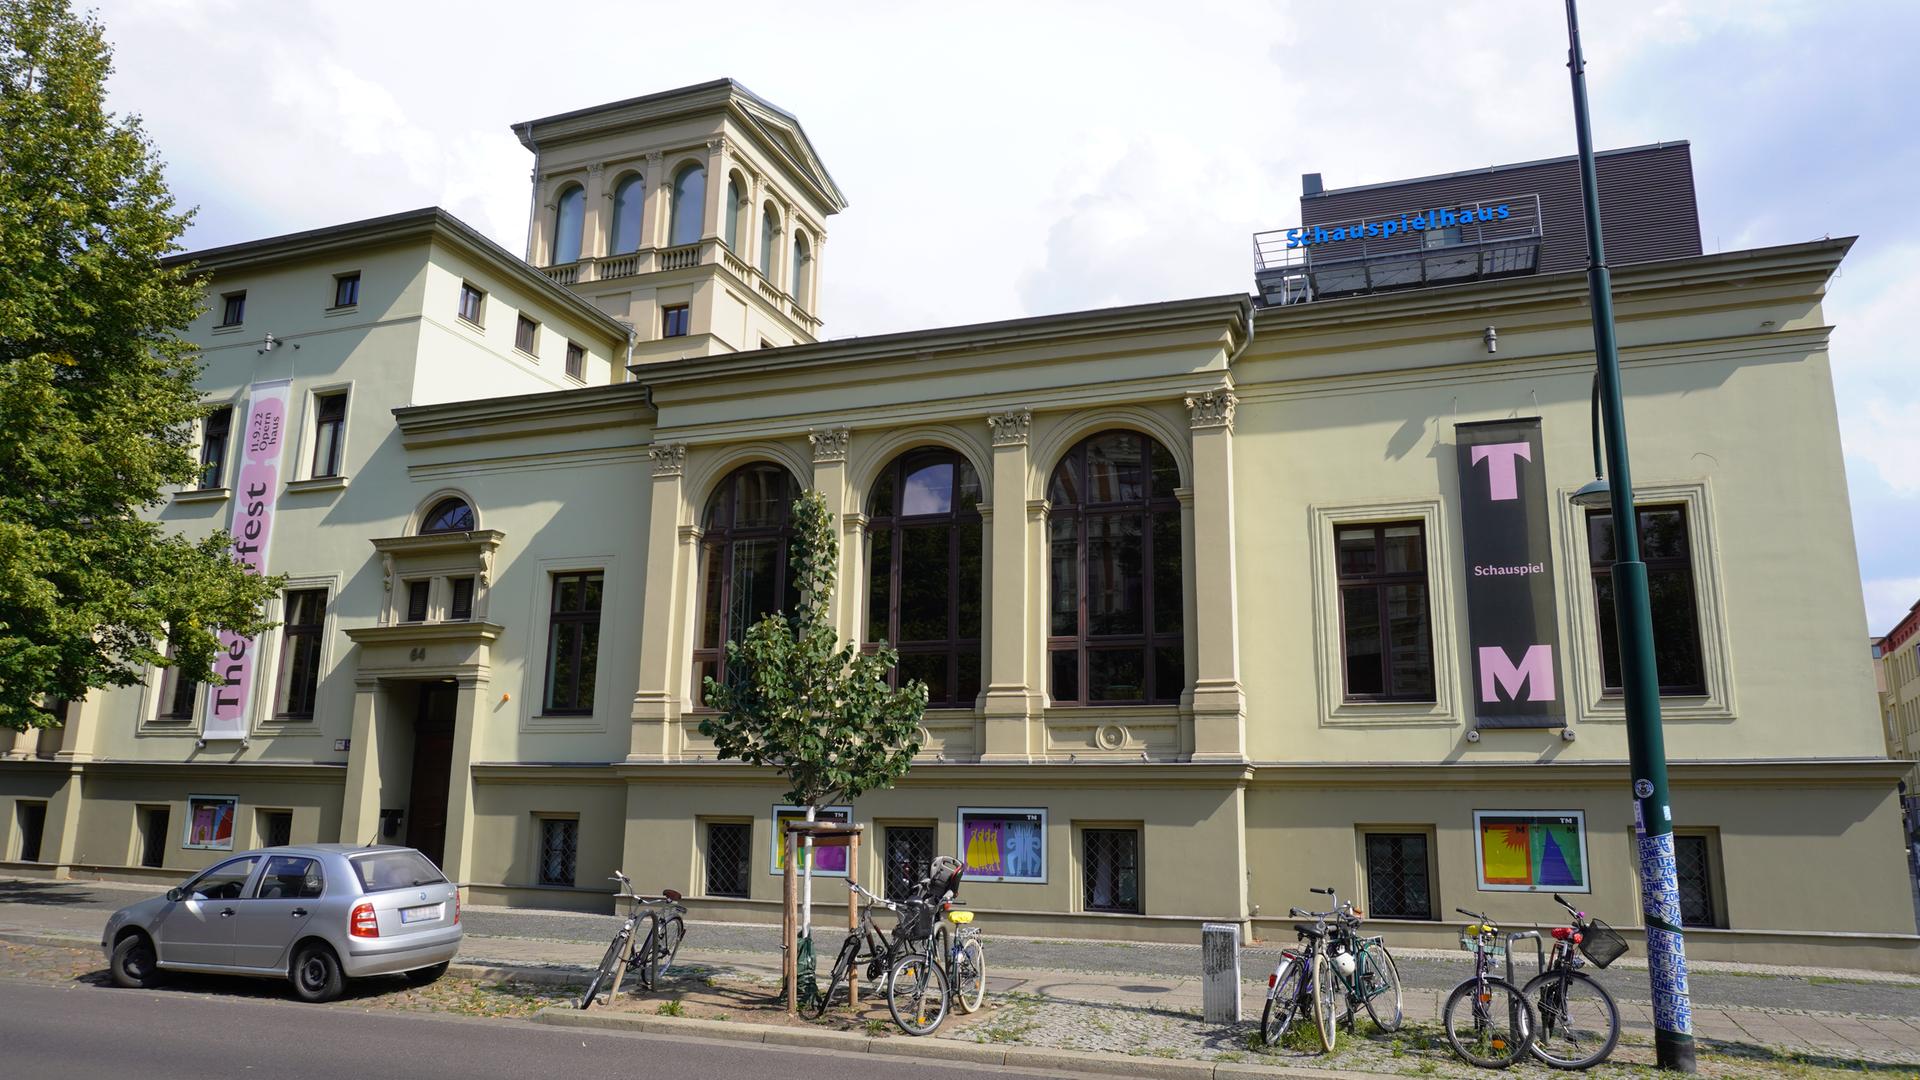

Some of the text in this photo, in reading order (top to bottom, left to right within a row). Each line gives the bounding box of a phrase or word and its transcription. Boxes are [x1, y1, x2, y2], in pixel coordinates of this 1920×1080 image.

[1286, 203, 1510, 248] Schauspielhaus
[251, 412, 264, 452] 11.9.22
[259, 412, 272, 451] Opern
[268, 416, 280, 445] haus
[1471, 441, 1532, 501] T
[1474, 562, 1545, 577] Schauspiel
[1478, 644, 1556, 703] M
